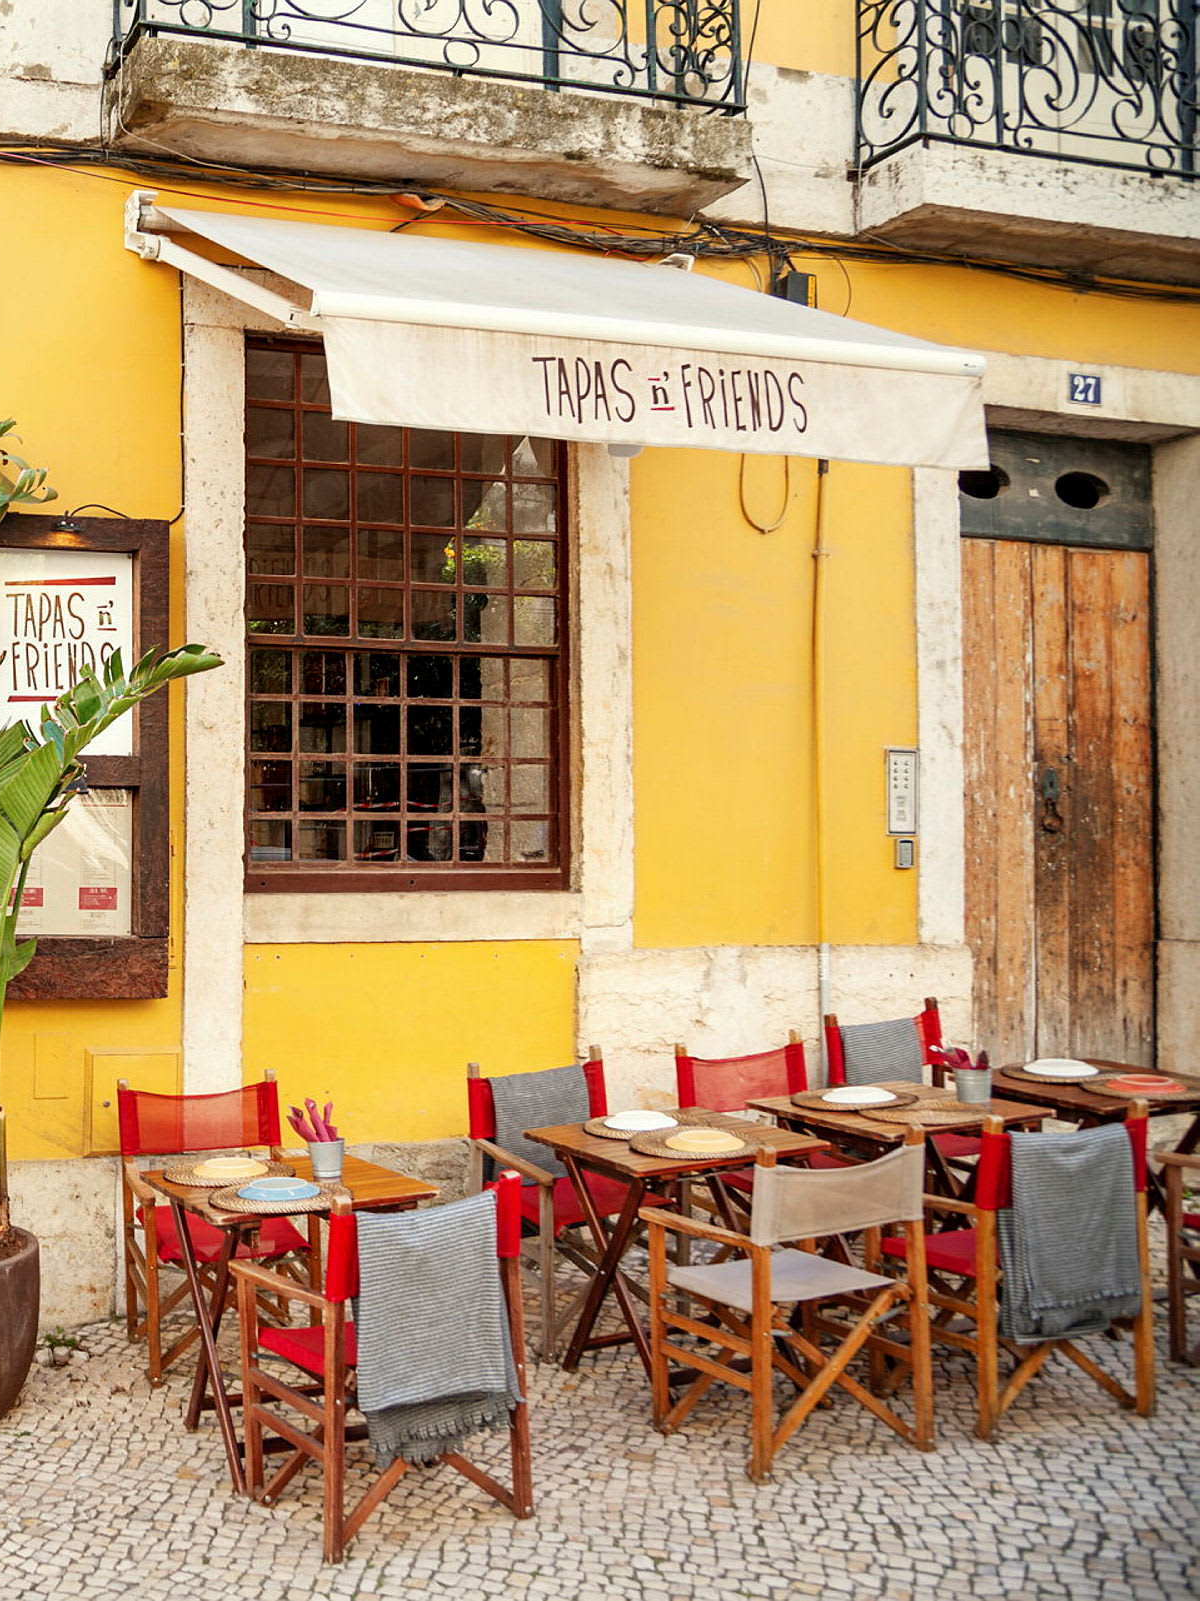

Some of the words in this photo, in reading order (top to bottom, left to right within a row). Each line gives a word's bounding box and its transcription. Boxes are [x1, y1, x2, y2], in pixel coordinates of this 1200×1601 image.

[532, 357, 636, 424] TAPAS
[1073, 376, 1097, 401] 27
[6, 592, 85, 641] TAPAS
